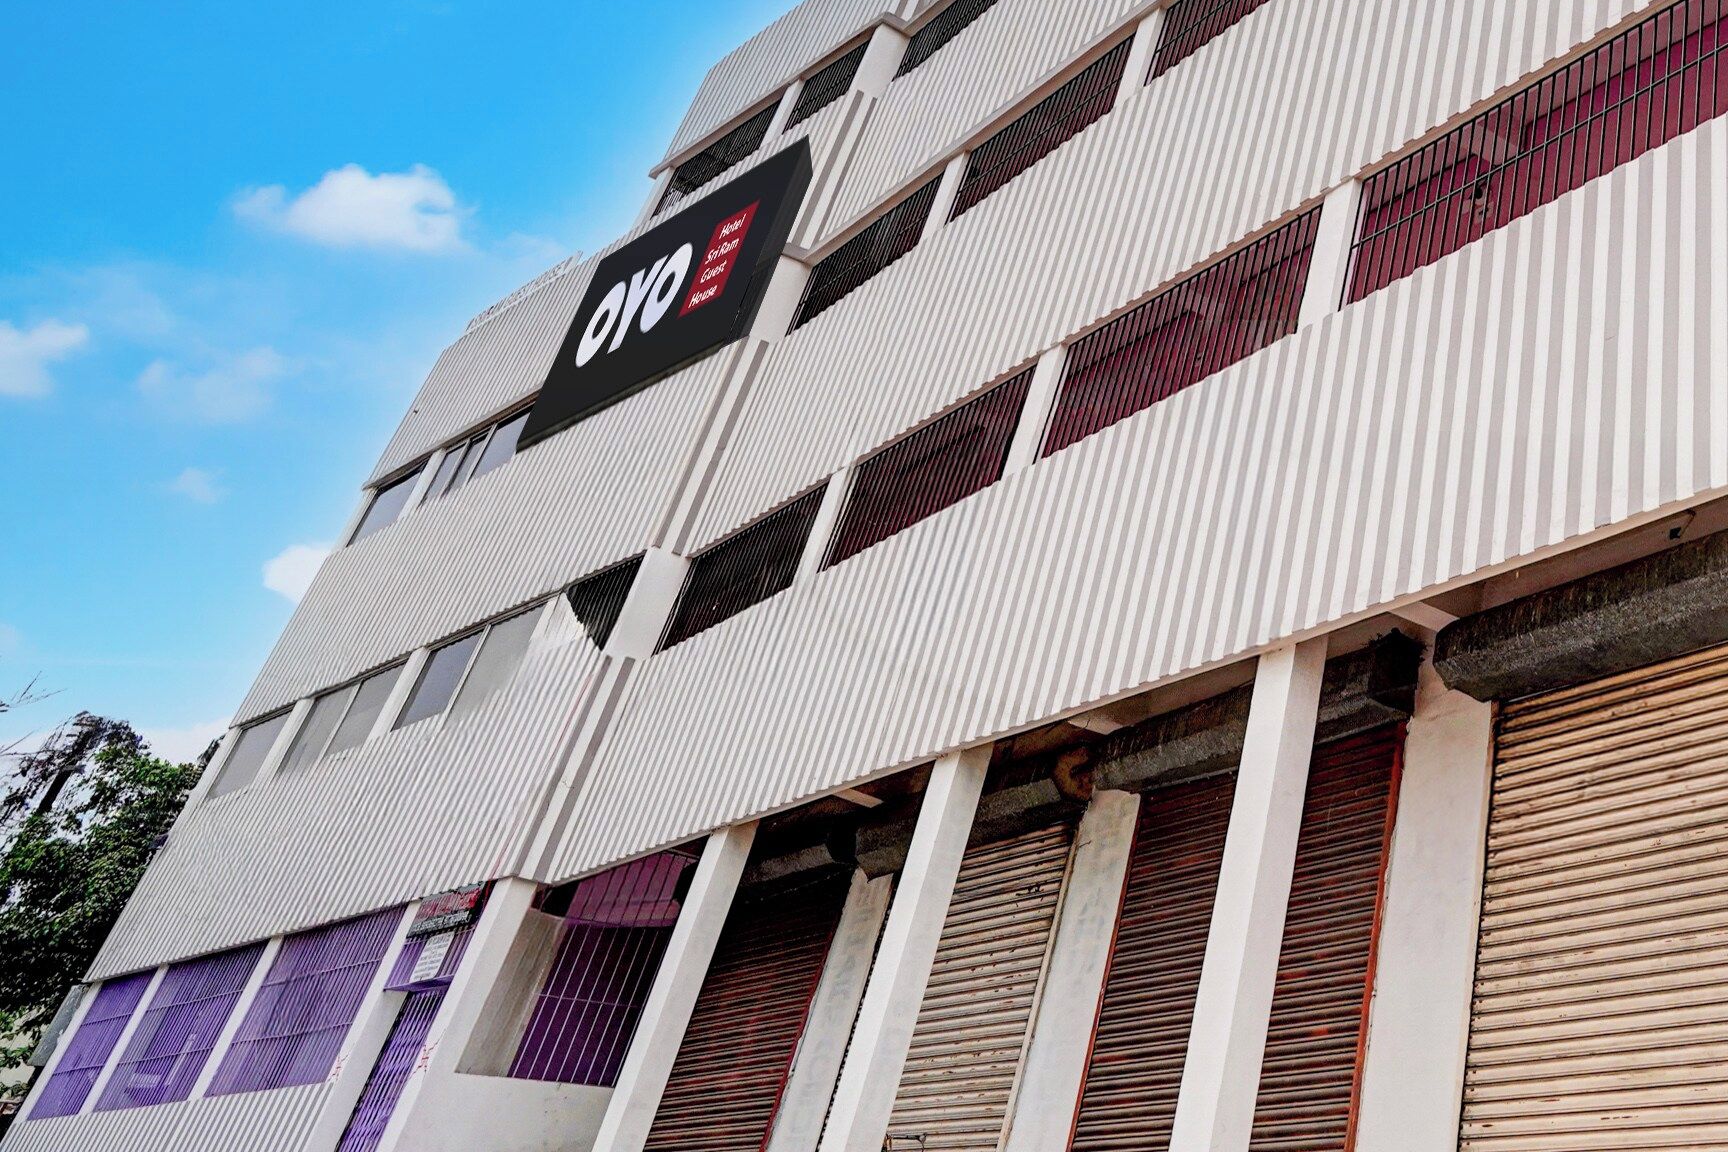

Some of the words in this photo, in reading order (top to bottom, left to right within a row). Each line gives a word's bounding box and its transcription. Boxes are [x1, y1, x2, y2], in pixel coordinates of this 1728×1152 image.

[718, 213, 747, 240] Hotel
[705, 245, 721, 265] Sri
[720, 238, 740, 260] Ram
[700, 259, 728, 284] Guest
[575, 242, 693, 368] OYO
[688, 285, 718, 309] House
